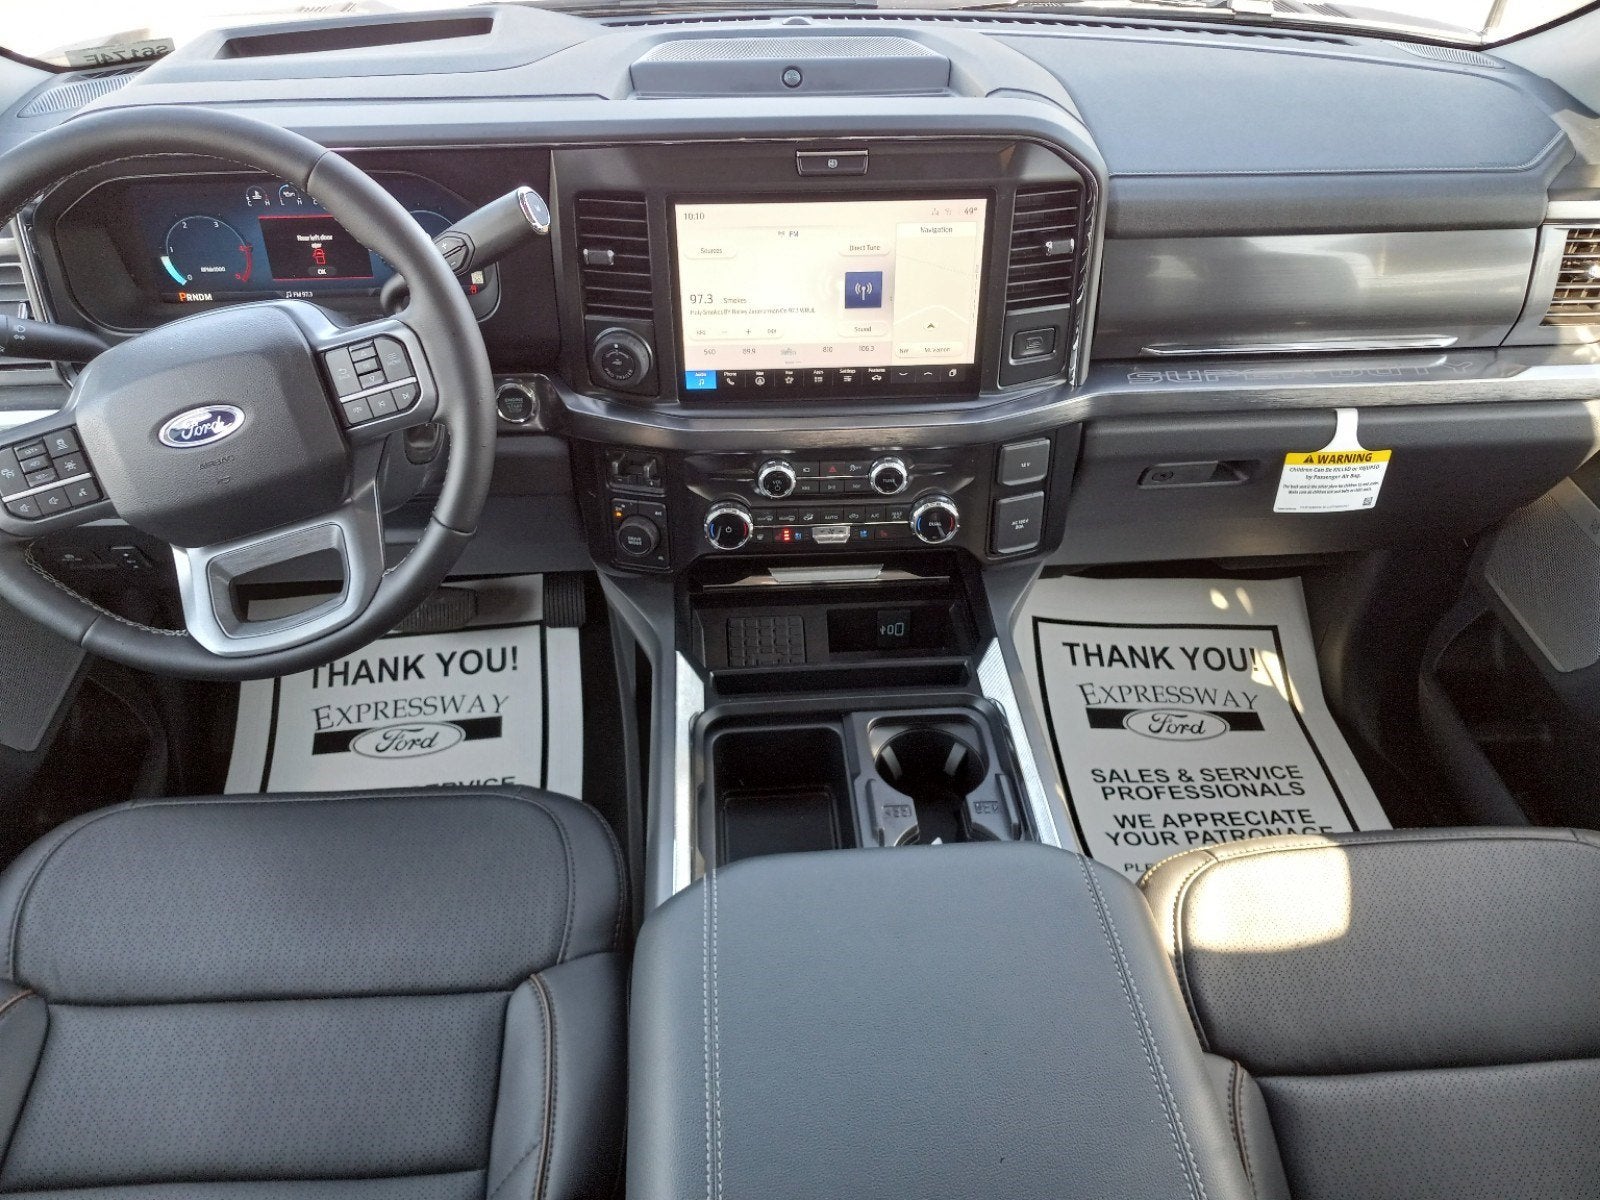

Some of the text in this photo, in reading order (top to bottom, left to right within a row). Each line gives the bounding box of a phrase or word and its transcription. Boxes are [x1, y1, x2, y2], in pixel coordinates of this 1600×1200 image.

[684, 212, 705, 220] 10:10
[920, 226, 953, 234] Navigation
[689, 294, 714, 304] 97.3
[1317, 453, 1372, 464] WARNING
[1061, 641, 1259, 672] THANK YOU!
[311, 646, 519, 690] THANK YOU!
[1077, 682, 1259, 710] EXPRESSWAY
[312, 693, 510, 731] EXPRESSWAY
[1148, 713, 1206, 734] Ford
[375, 728, 440, 754] Ford
[1090, 765, 1304, 784] SALES & SERVICE
[1100, 781, 1306, 800] PROFESSIONALS
[1113, 809, 1316, 829] WE APPRECIATE
[1105, 830, 1178, 846] YOUR
